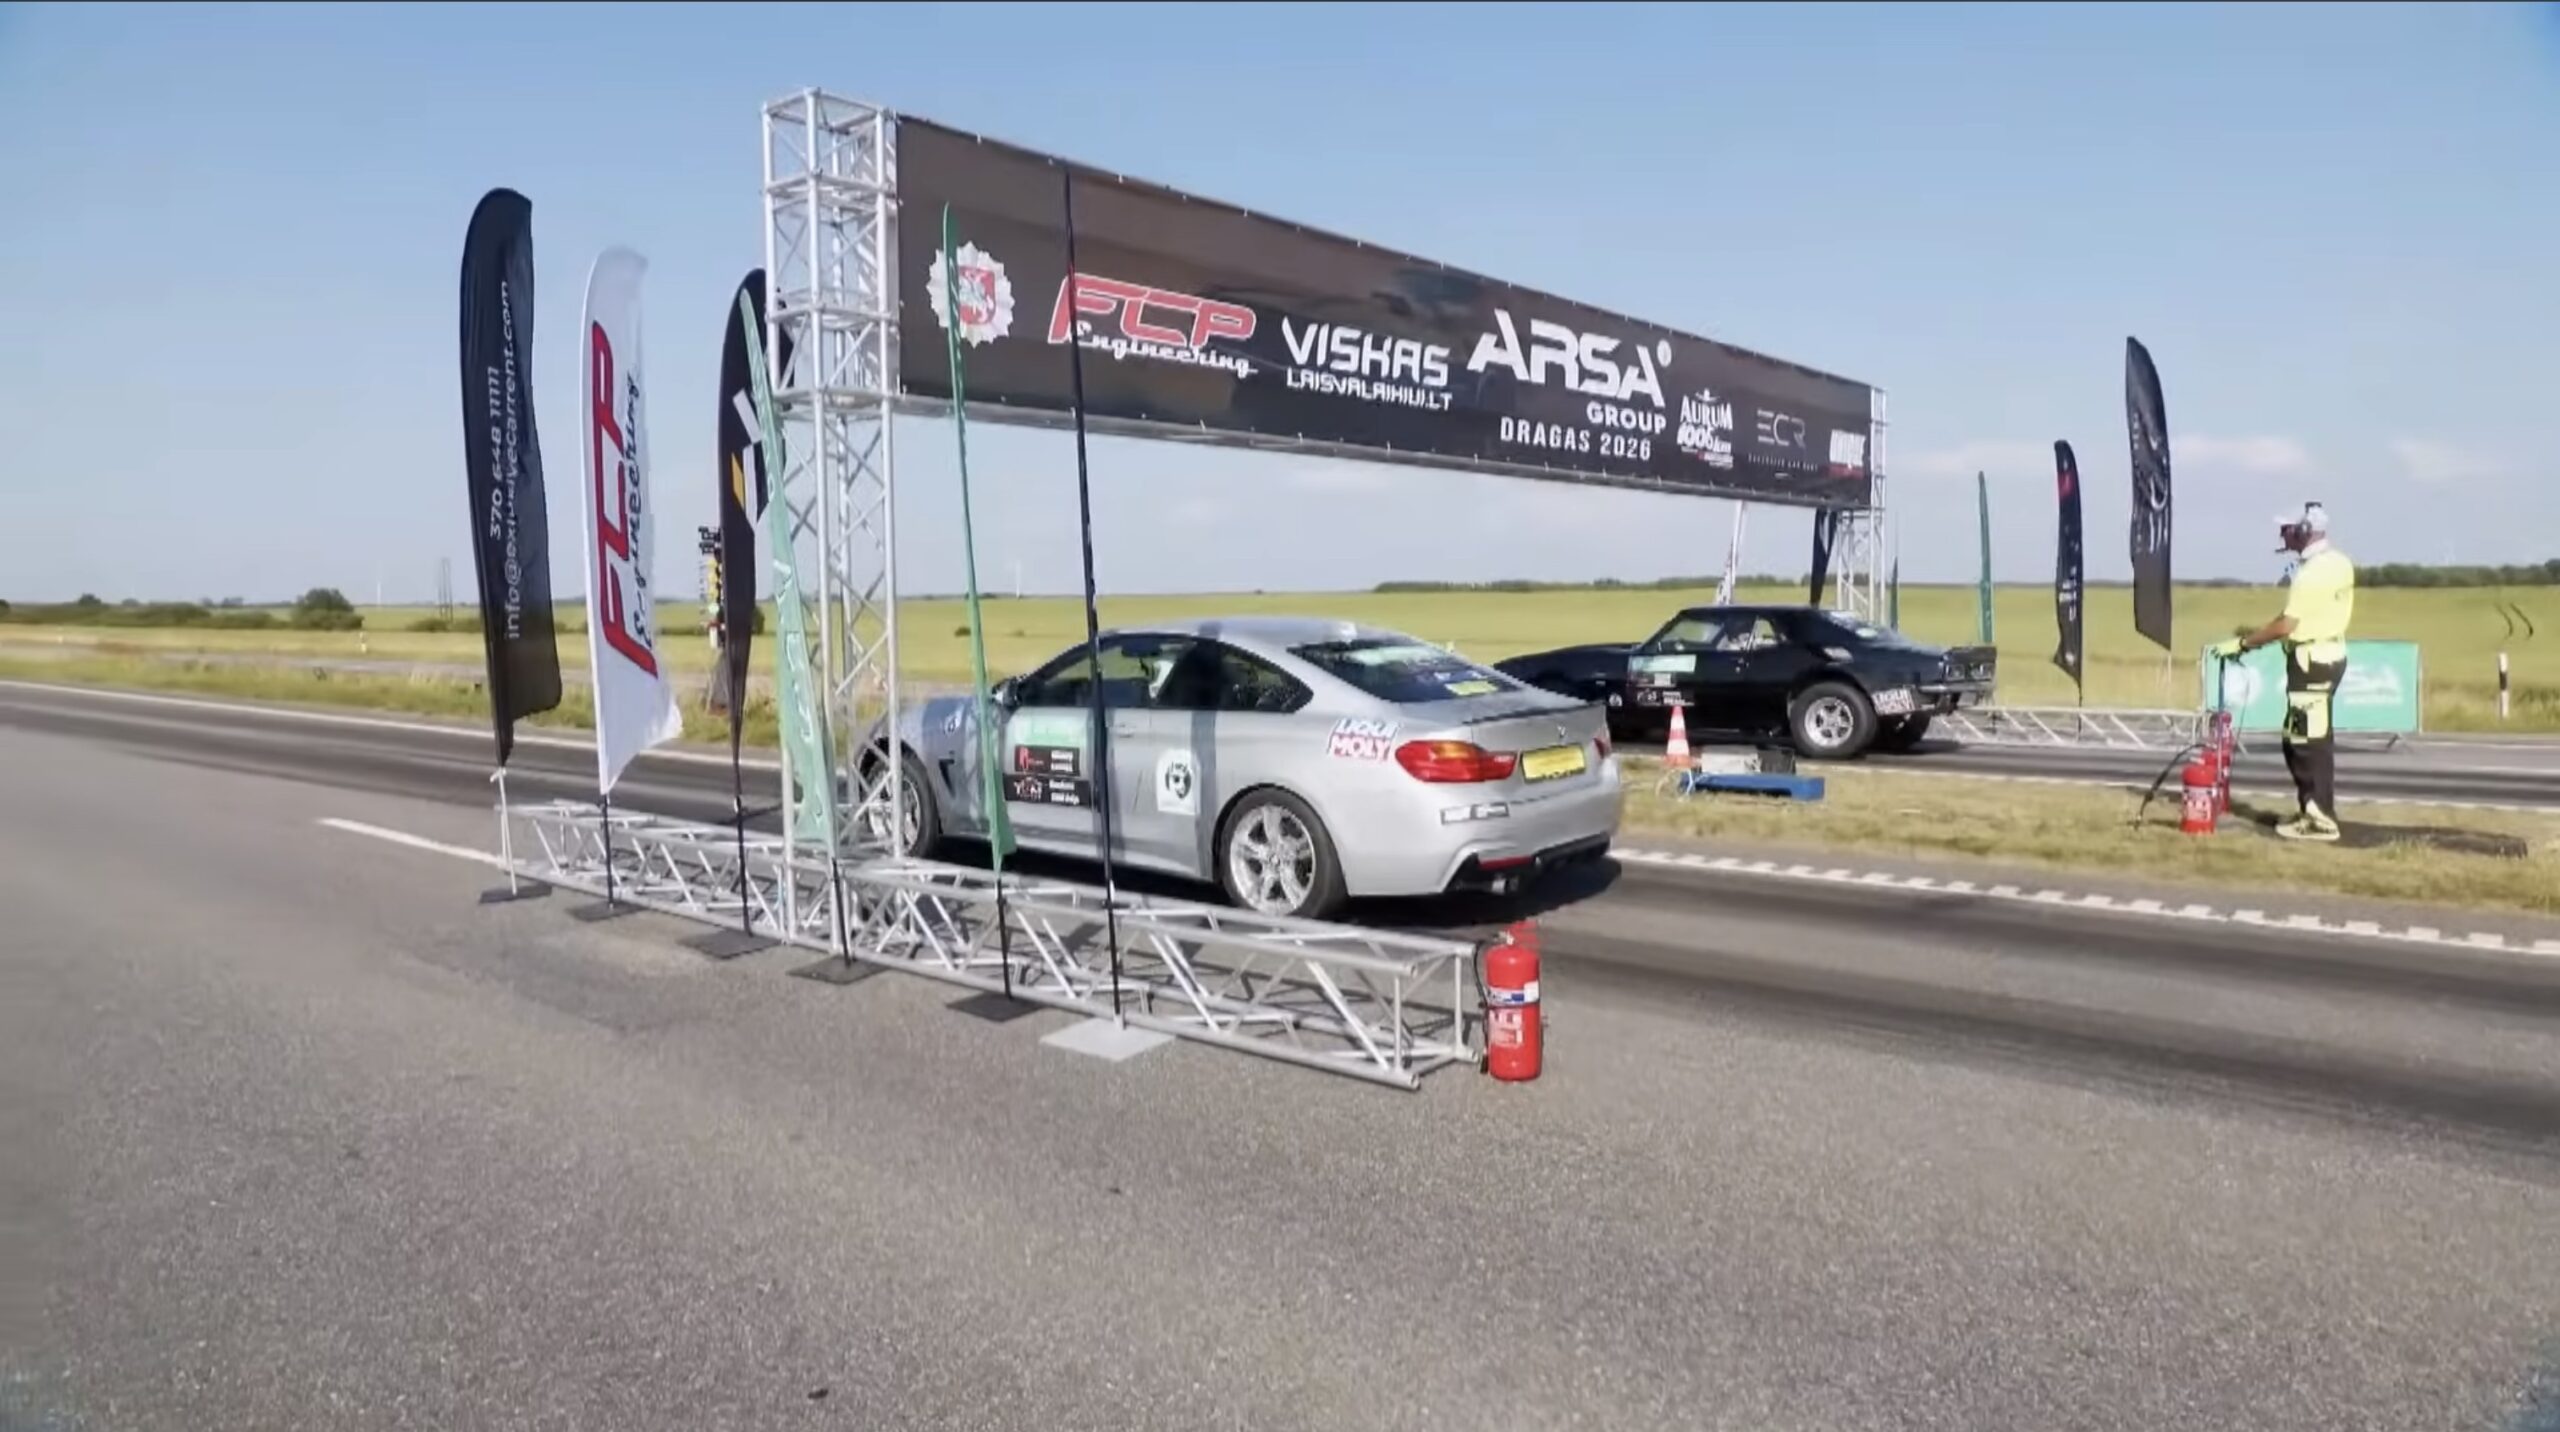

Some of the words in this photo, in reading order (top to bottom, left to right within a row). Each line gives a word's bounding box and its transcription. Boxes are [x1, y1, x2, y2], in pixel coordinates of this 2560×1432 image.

[1048, 273, 1258, 349] FCP
[1070, 320, 1259, 379] Engineering
[1281, 315, 1450, 387] VISKAS
[1466, 307, 1666, 408] ARSA
[1501, 415, 1591, 452] DRAGAS
[1599, 432, 1651, 461] 2026
[1586, 400, 1667, 435] GROUP
[1679, 394, 1734, 431] AURUM
[1756, 409, 1806, 449] ECR
[489, 488, 502, 541] 370
[592, 320, 659, 680] FCP
[1331, 733, 1392, 763] MOLY
